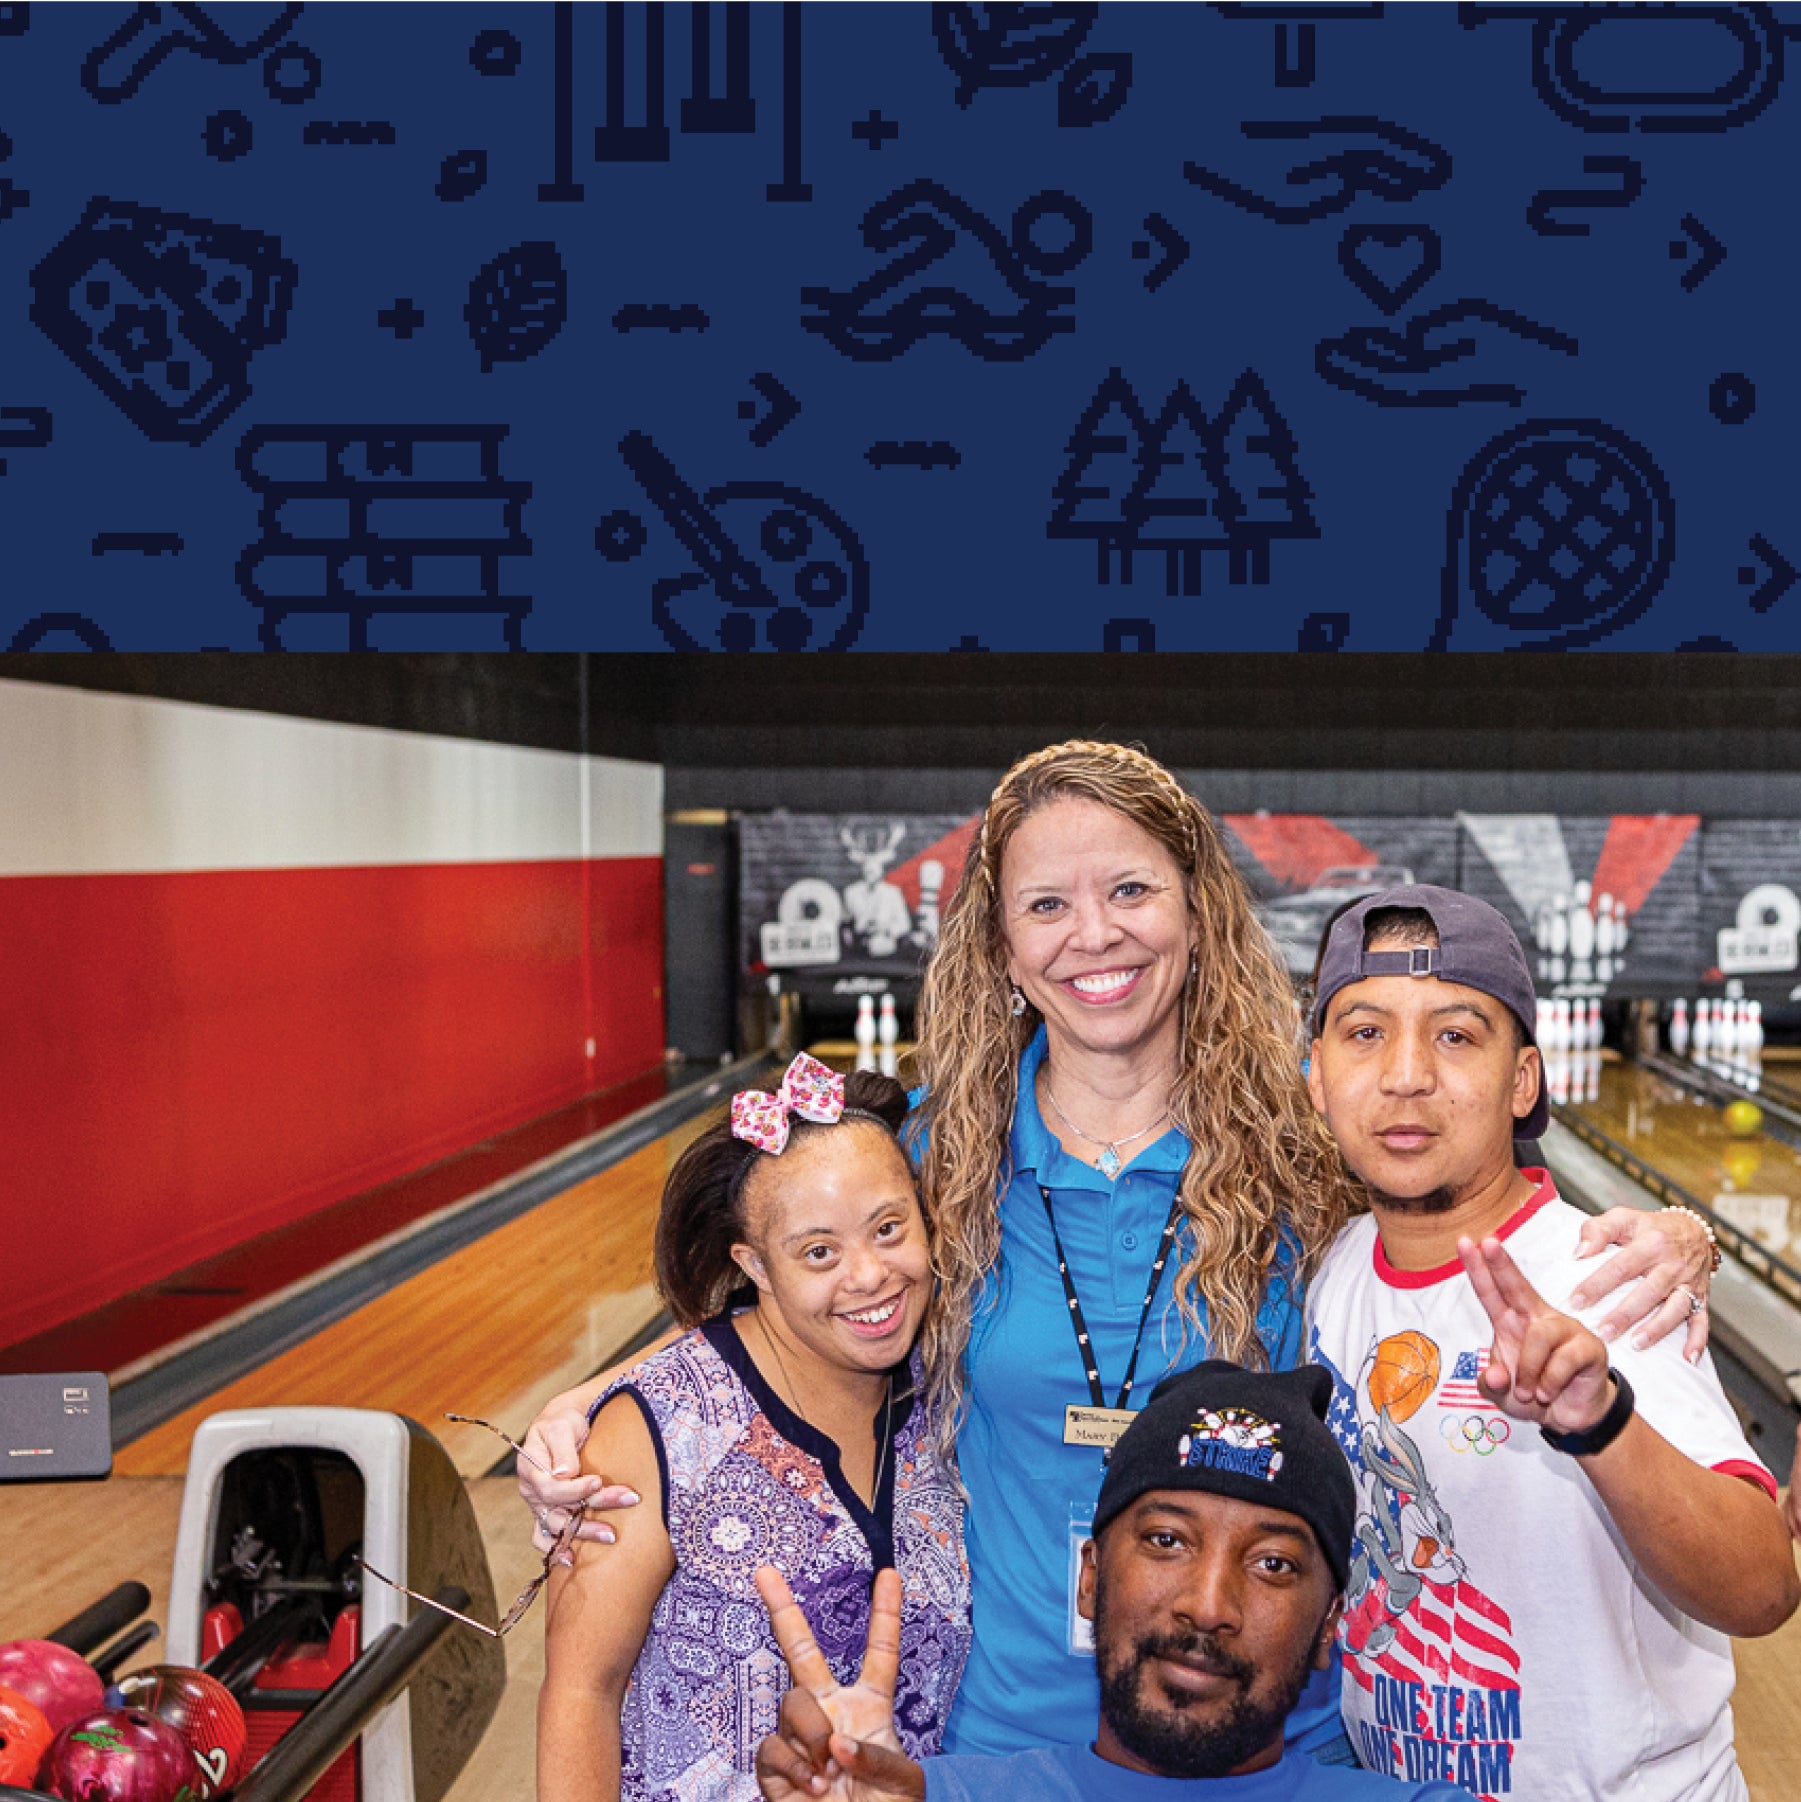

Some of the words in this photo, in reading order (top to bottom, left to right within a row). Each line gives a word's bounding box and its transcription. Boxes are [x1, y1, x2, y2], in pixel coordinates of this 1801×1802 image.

[1188, 1436, 1274, 1480] STRIKE
[1375, 1674, 1423, 1734] ONE
[1431, 1684, 1521, 1740] TEAM
[1360, 1720, 1401, 1782] ONE
[1402, 1735, 1512, 1793] DREAM
